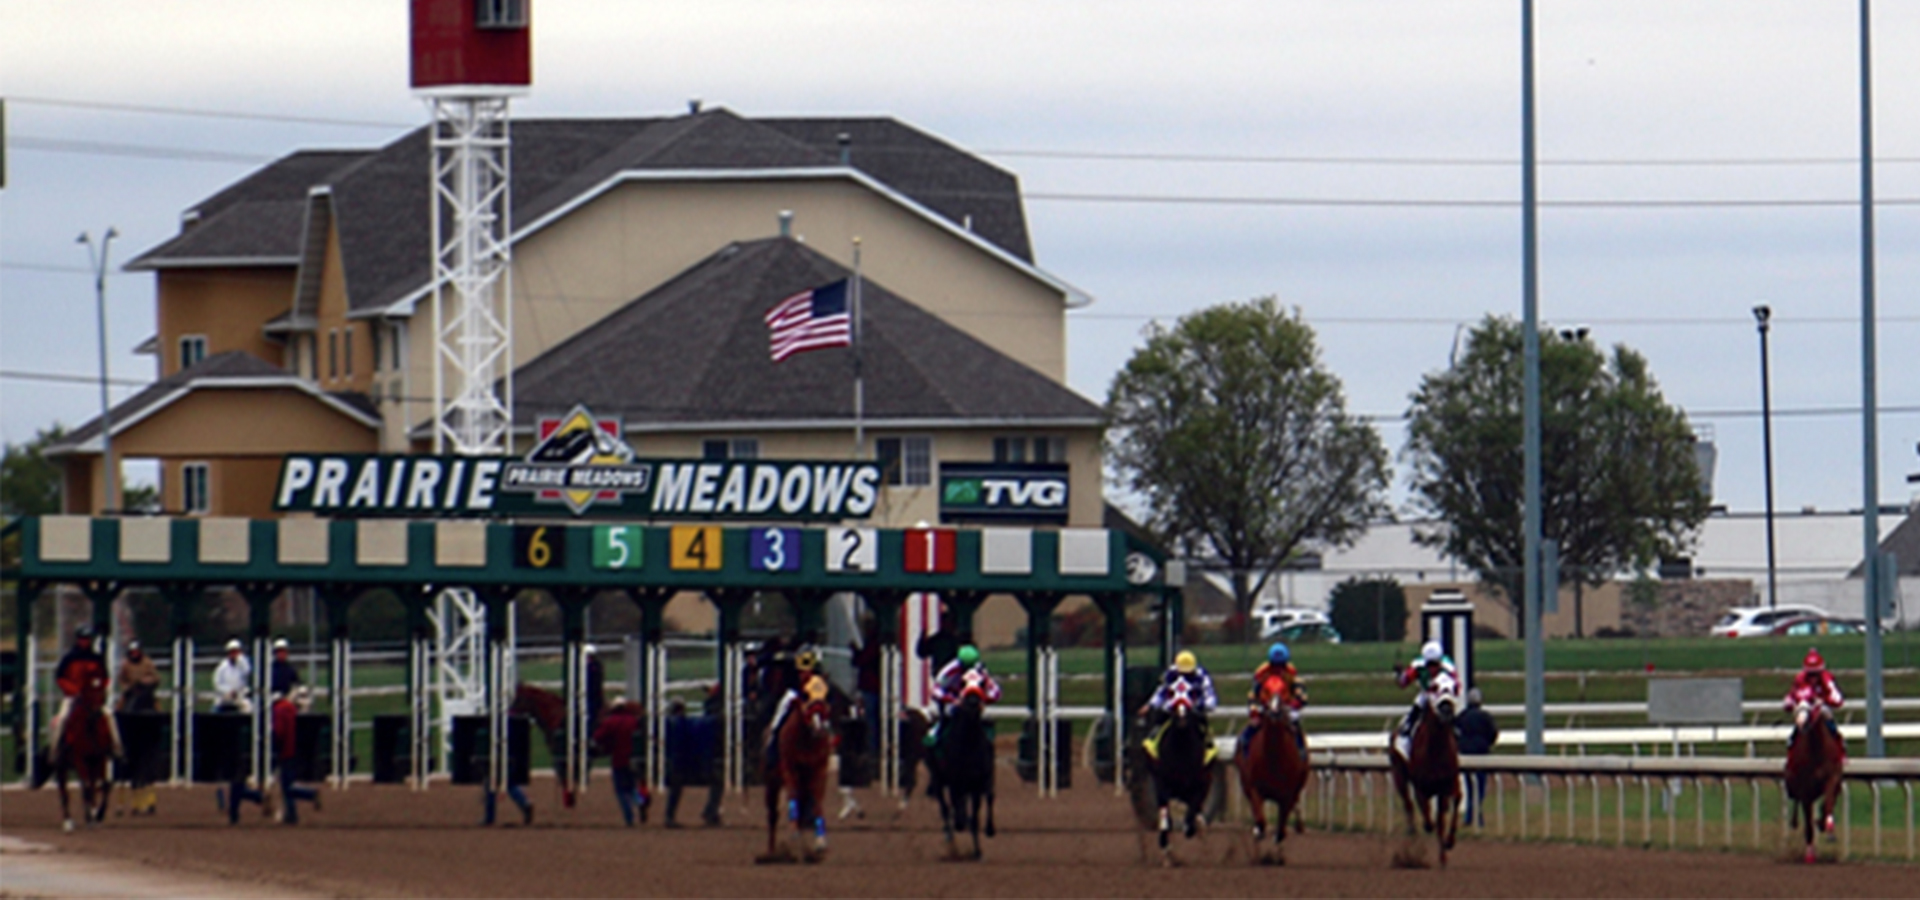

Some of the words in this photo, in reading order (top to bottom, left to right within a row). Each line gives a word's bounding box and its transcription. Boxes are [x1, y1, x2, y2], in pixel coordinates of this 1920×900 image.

[278, 458, 500, 509] PRAIRIE
[651, 464, 878, 514] MEADOWS
[508, 468, 566, 485] PRAIRIE
[572, 469, 645, 487] MEADOWS
[982, 480, 1067, 506] TVG
[529, 528, 550, 567] 6
[608, 527, 629, 568] 5
[686, 529, 707, 570] 4
[763, 529, 786, 570] 3
[842, 530, 862, 571] 2
[923, 530, 935, 572] 1
